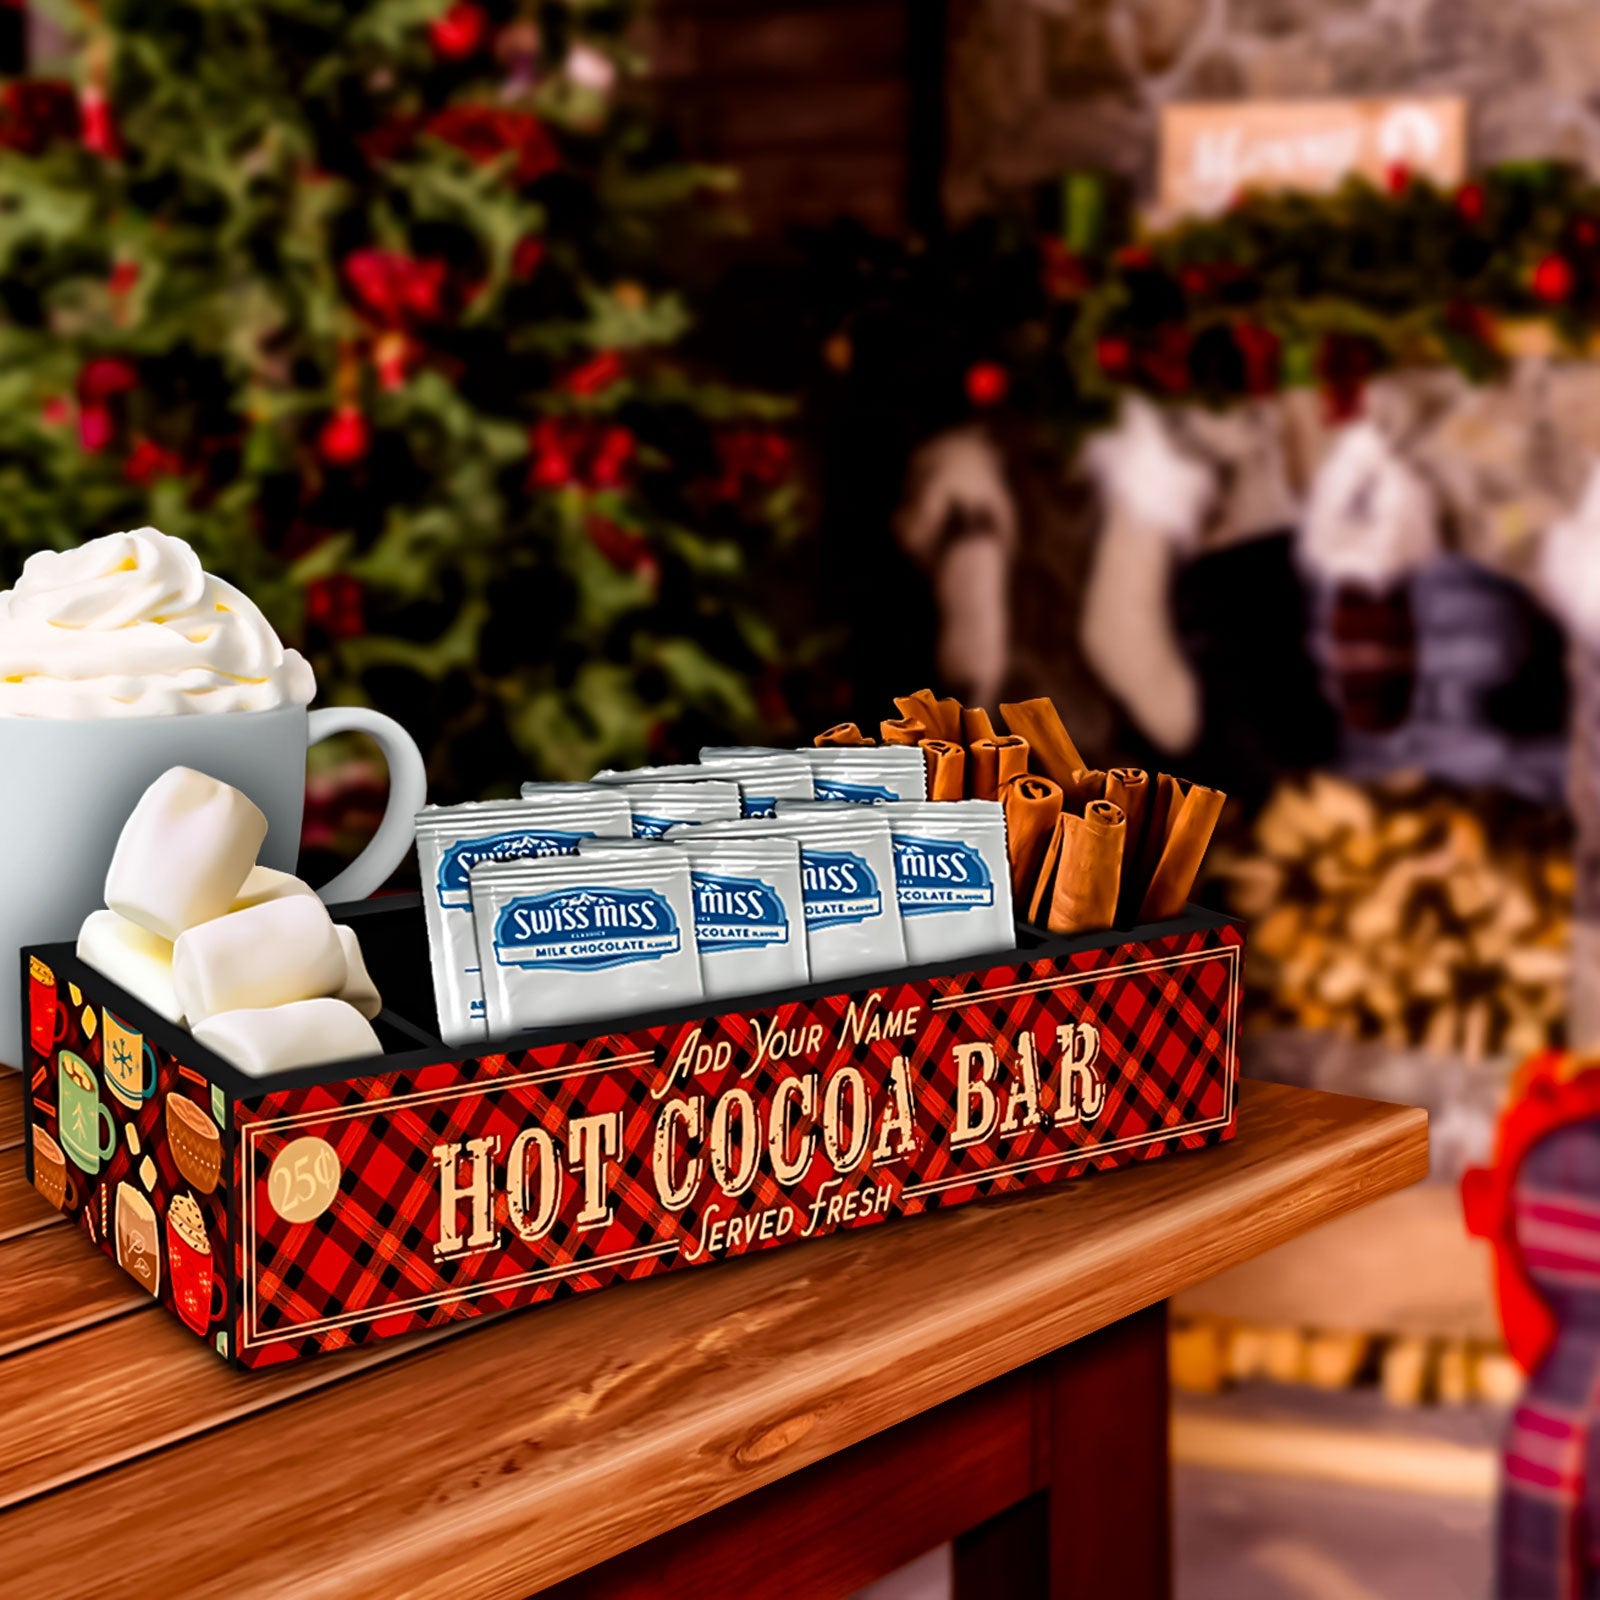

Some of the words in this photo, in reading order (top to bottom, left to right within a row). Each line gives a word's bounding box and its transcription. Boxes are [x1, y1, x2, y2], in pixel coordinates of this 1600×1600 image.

[804, 904, 844, 916] OLATE
[896, 891, 953, 901] COLATE
[513, 906, 590, 940] SWISS
[594, 900, 658, 931] MISS
[694, 928, 750, 939] COLATE
[535, 946, 567, 957] MILK
[570, 941, 645, 954] CHOCOLATE
[650, 1028, 732, 1099] ADD
[740, 1014, 823, 1079] YOUR
[837, 993, 921, 1050] NAME
[432, 1111, 623, 1264] HOT
[652, 1055, 924, 1212] COCOA
[950, 1022, 1106, 1150] BAR
[273, 1147, 336, 1213] 25¢
[684, 1203, 794, 1261] SERVED
[800, 1177, 893, 1238] FRESH
